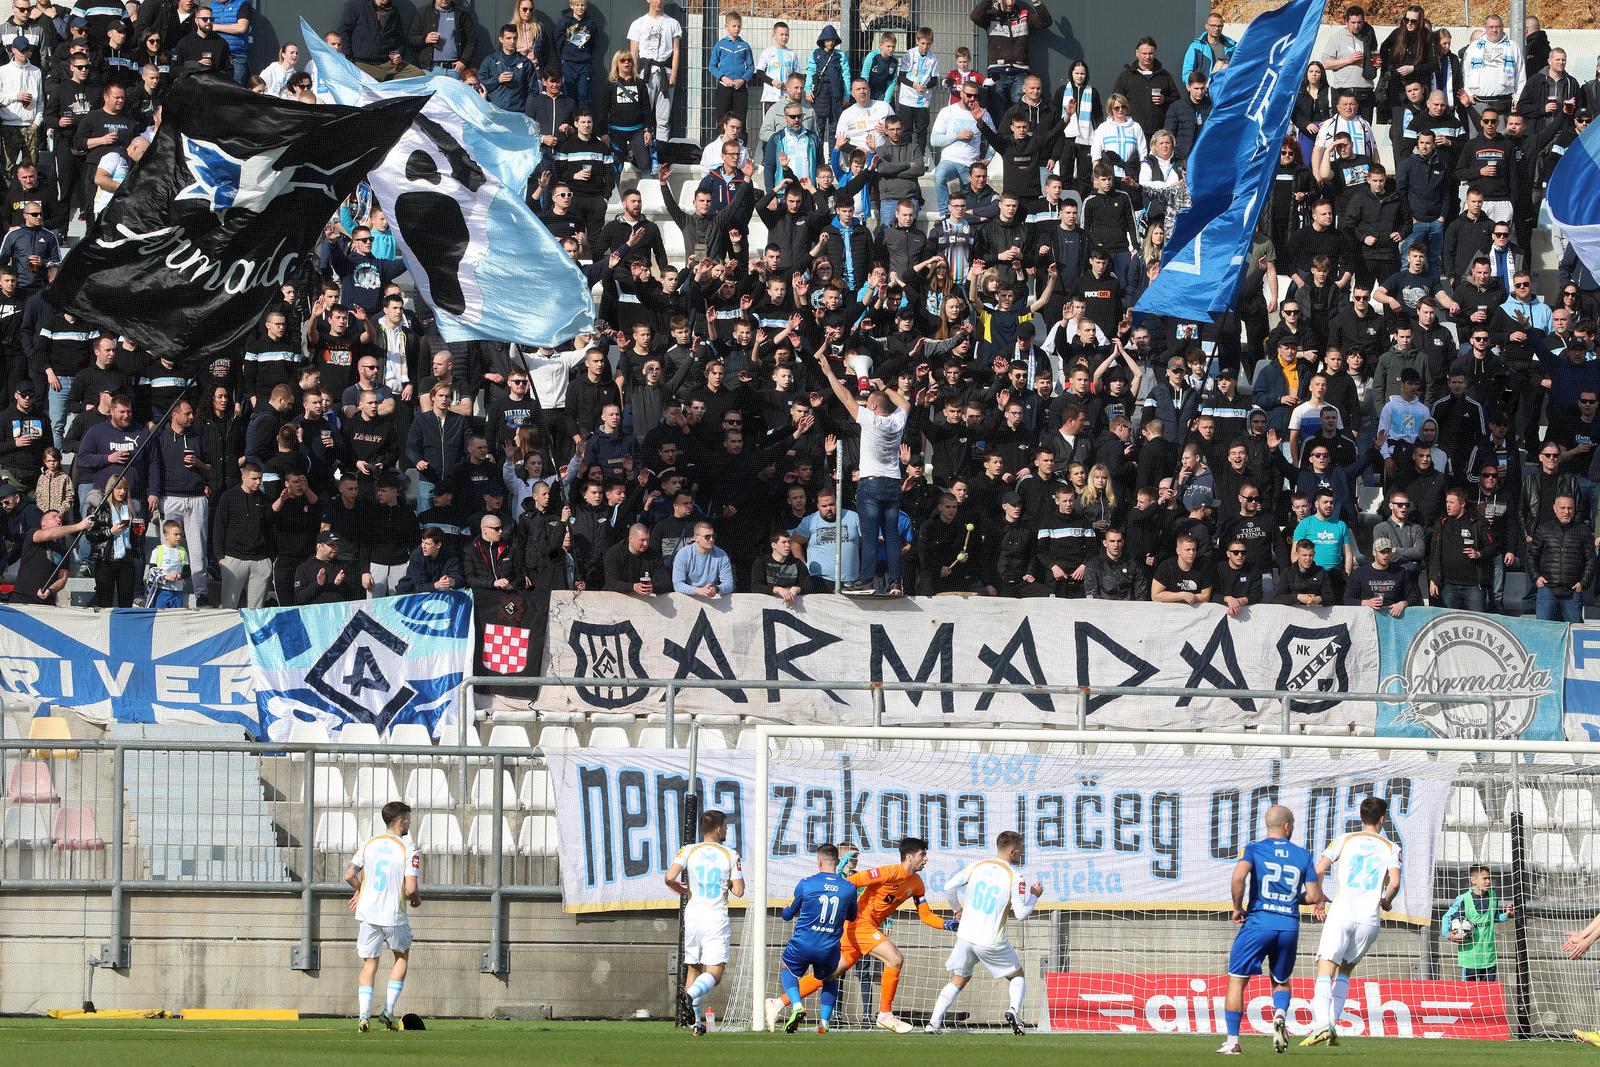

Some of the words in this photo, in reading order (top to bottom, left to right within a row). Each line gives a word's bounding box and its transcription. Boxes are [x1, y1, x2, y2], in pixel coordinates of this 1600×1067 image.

[109, 442, 134, 451] PUMA
[659, 608, 1258, 715] ARMADA
[1286, 640, 1342, 692] RIJEKA
[1296, 644, 1310, 656] NK
[1429, 625, 1516, 668] ORIGINAL
[1, 656, 257, 705] RIVER
[1380, 653, 1553, 704] Armada
[969, 754, 1041, 787] 1987
[578, 765, 743, 887] nema
[772, 754, 986, 856] zakona
[373, 859, 389, 893] 5
[1037, 862, 1123, 903] rijeka
[1262, 861, 1301, 902] 23
[818, 894, 840, 925] 11
[971, 880, 1000, 916] 66
[1145, 978, 1415, 1039] aircash
